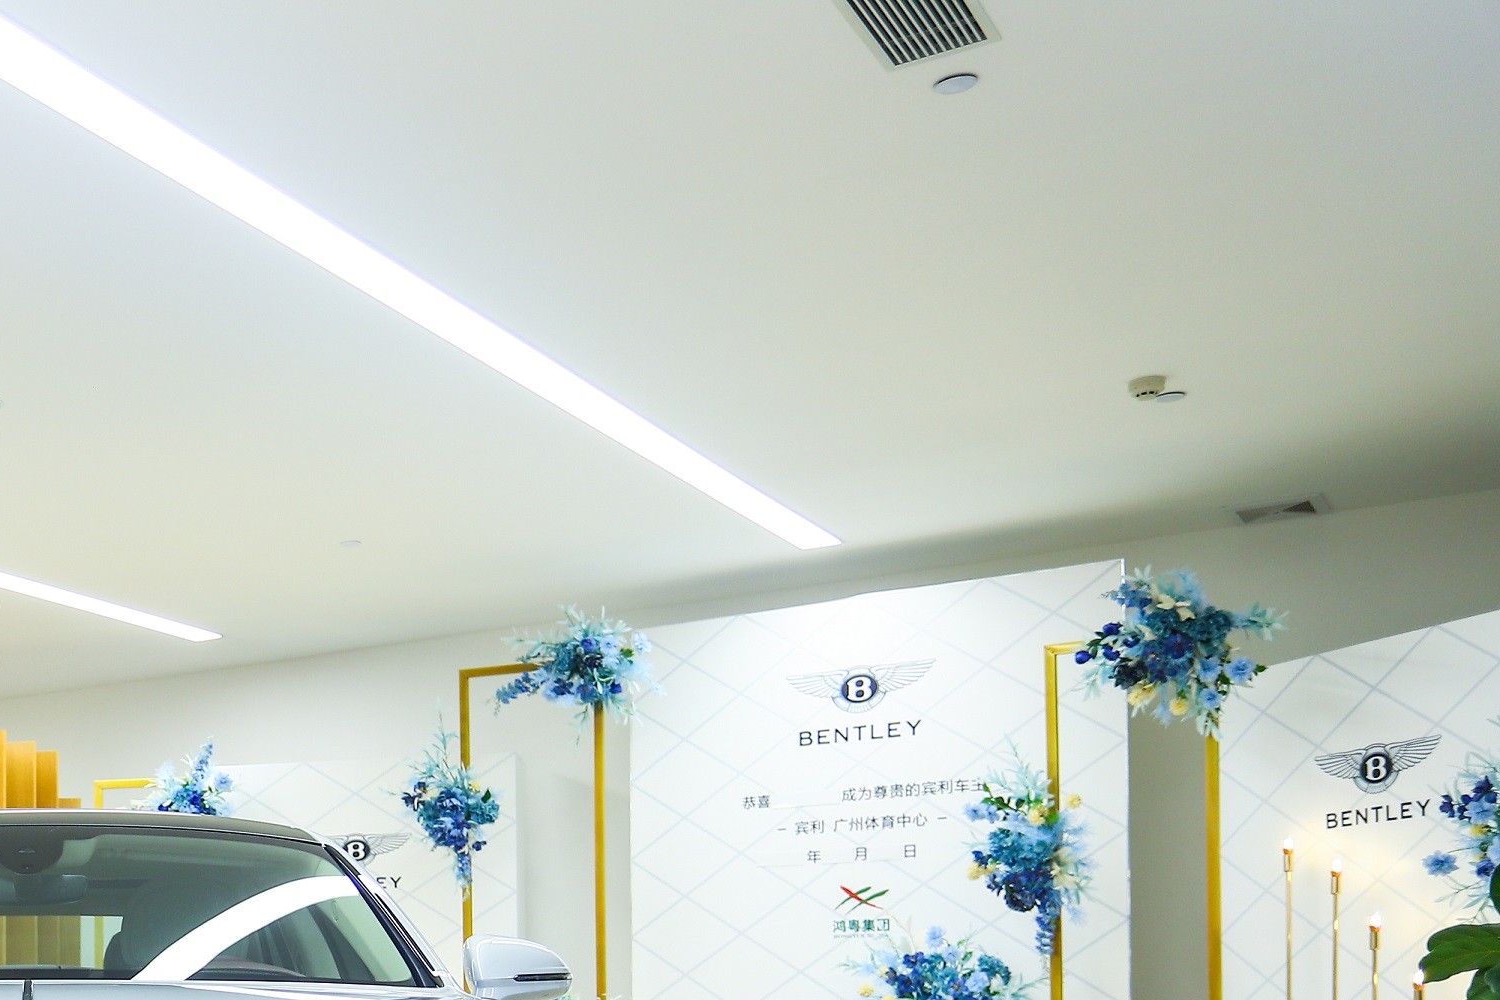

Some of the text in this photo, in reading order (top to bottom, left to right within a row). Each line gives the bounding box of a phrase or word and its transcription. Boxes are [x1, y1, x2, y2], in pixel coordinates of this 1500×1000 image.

[799, 719, 922, 746] BENTLEY
[742, 795, 771, 809] 恭喜
[795, 813, 928, 835] 宾利 广州体育中心
[1326, 799, 1430, 829] BENTLEY
[806, 844, 916, 863] 年 月 日
[833, 918, 889, 932] 鸿粤集团
